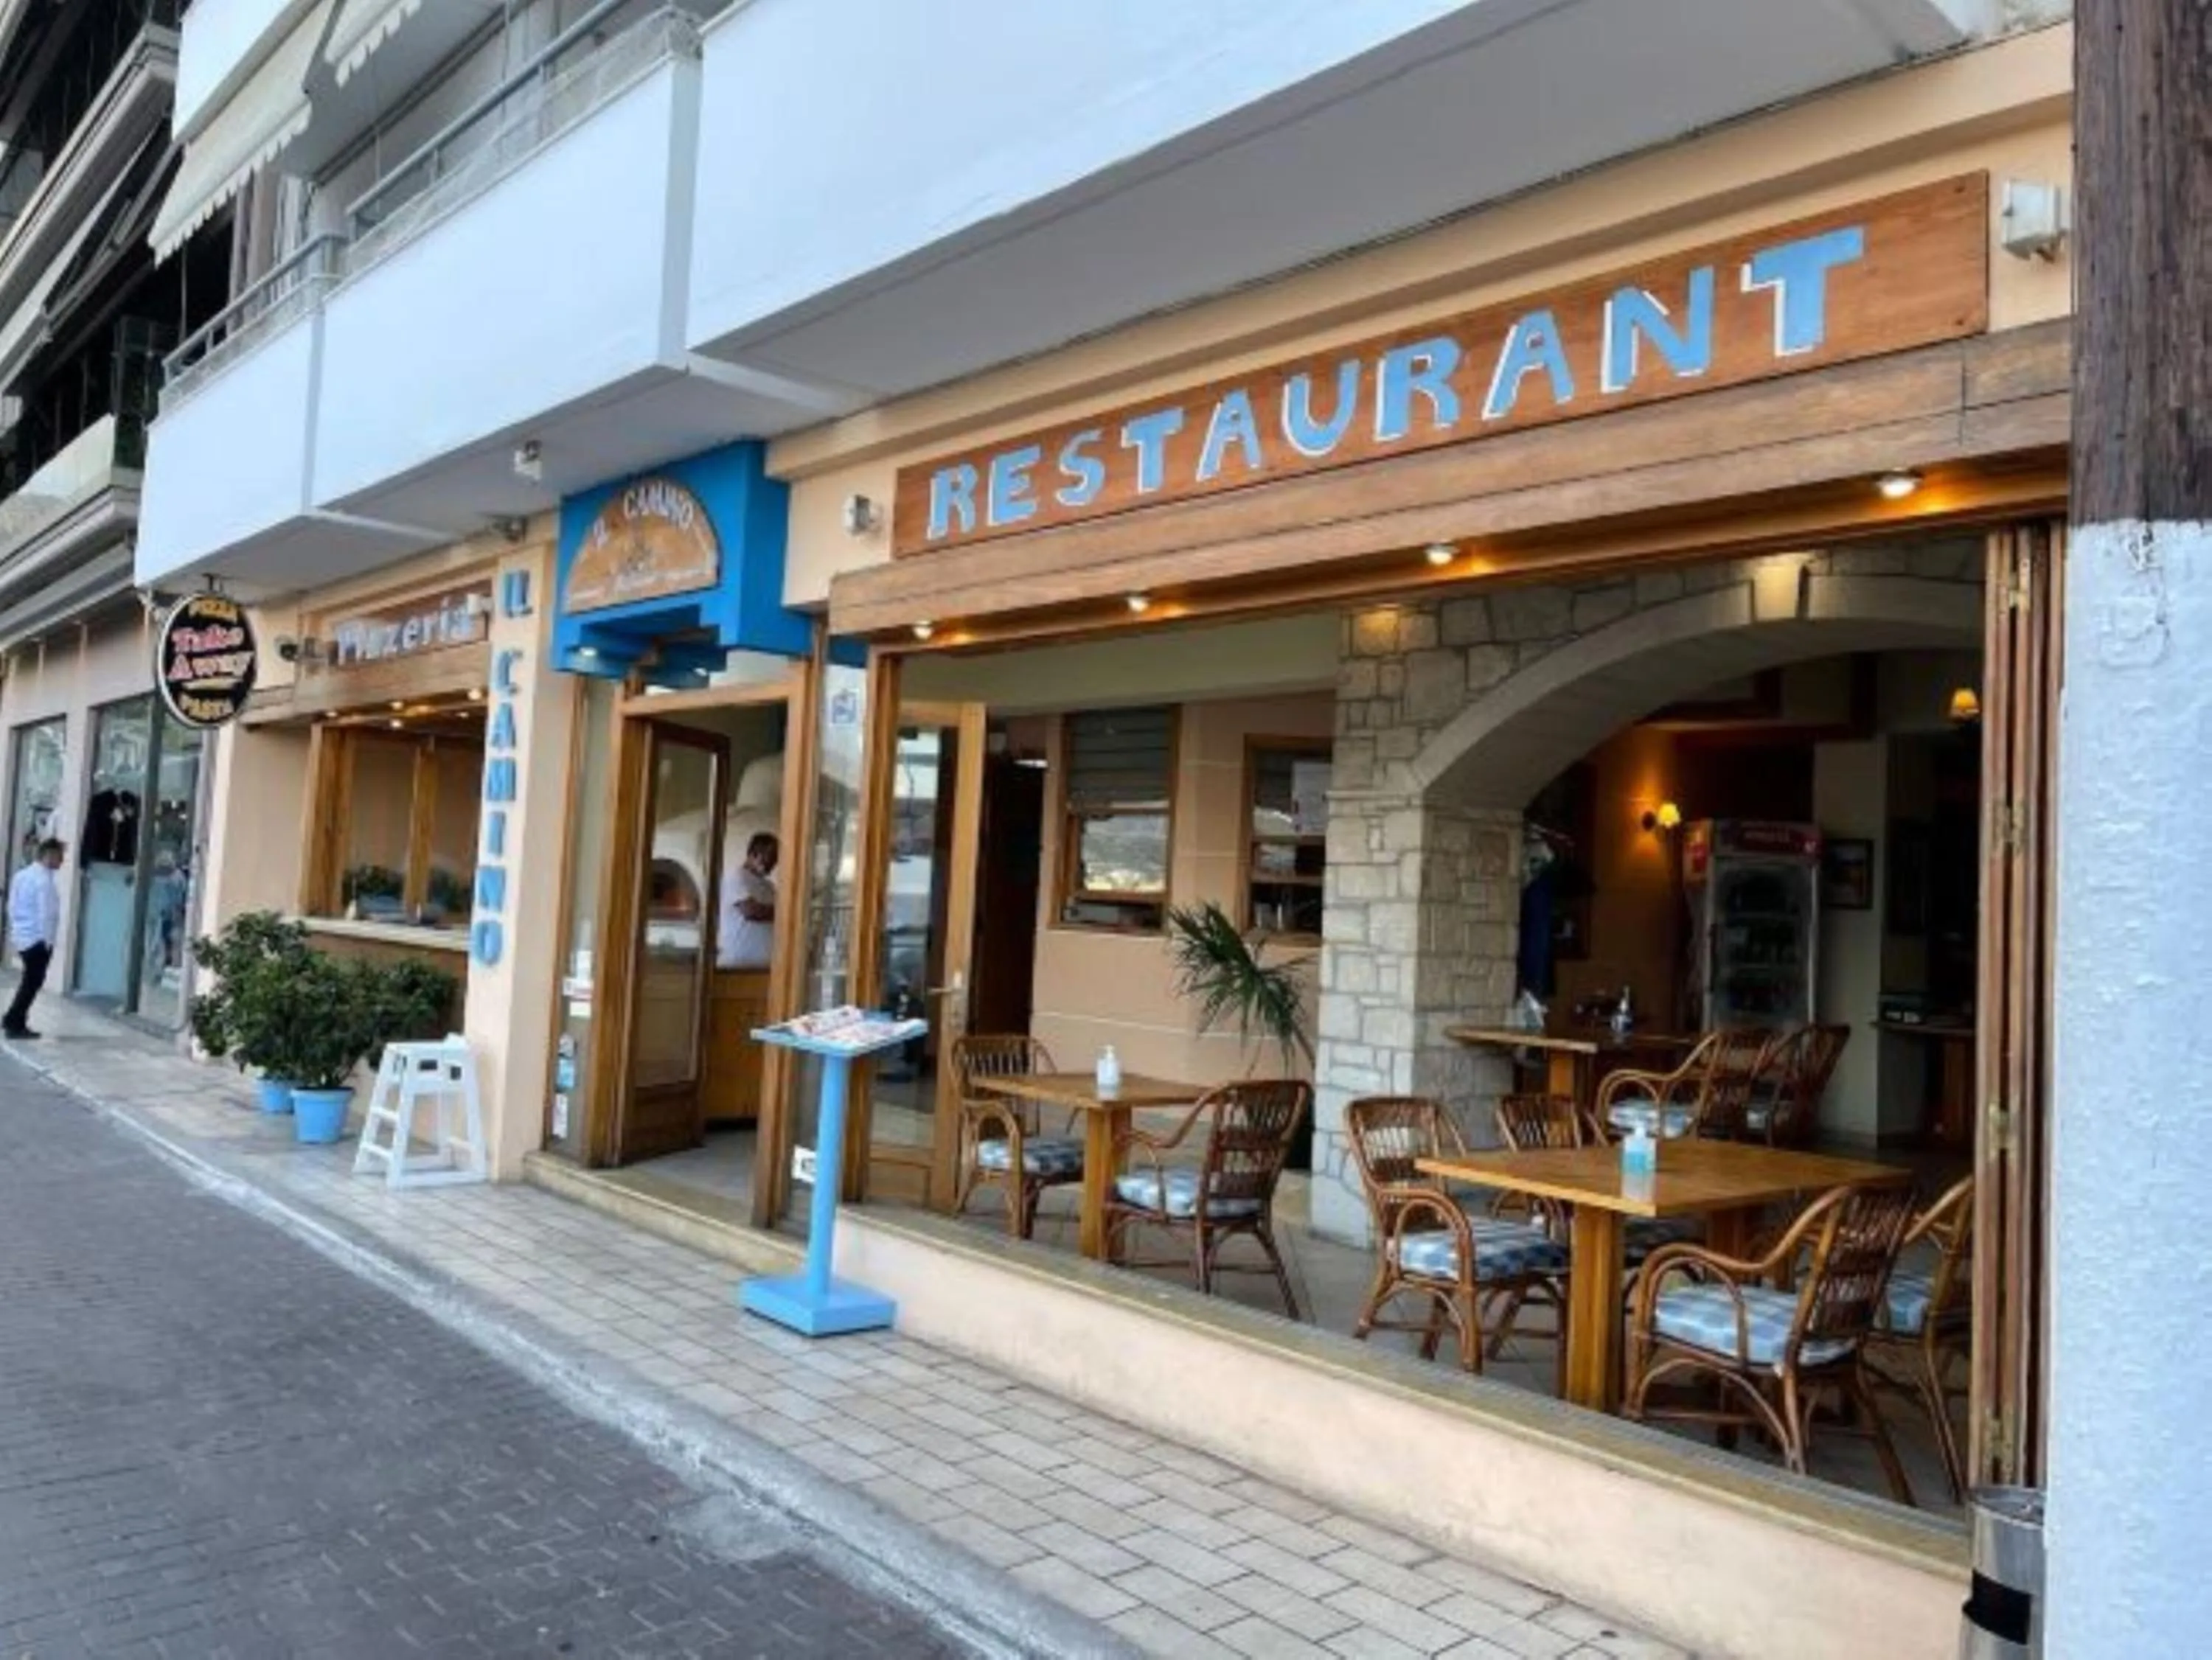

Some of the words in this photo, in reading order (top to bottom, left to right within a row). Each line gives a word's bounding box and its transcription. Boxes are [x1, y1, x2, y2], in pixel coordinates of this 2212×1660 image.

[927, 225, 1865, 541] RESTAURANT
[623, 481, 694, 531] CAMINO
[171, 626, 245, 655] Take
[178, 691, 234, 720] PASTA
[472, 649, 524, 966] CAMINO
